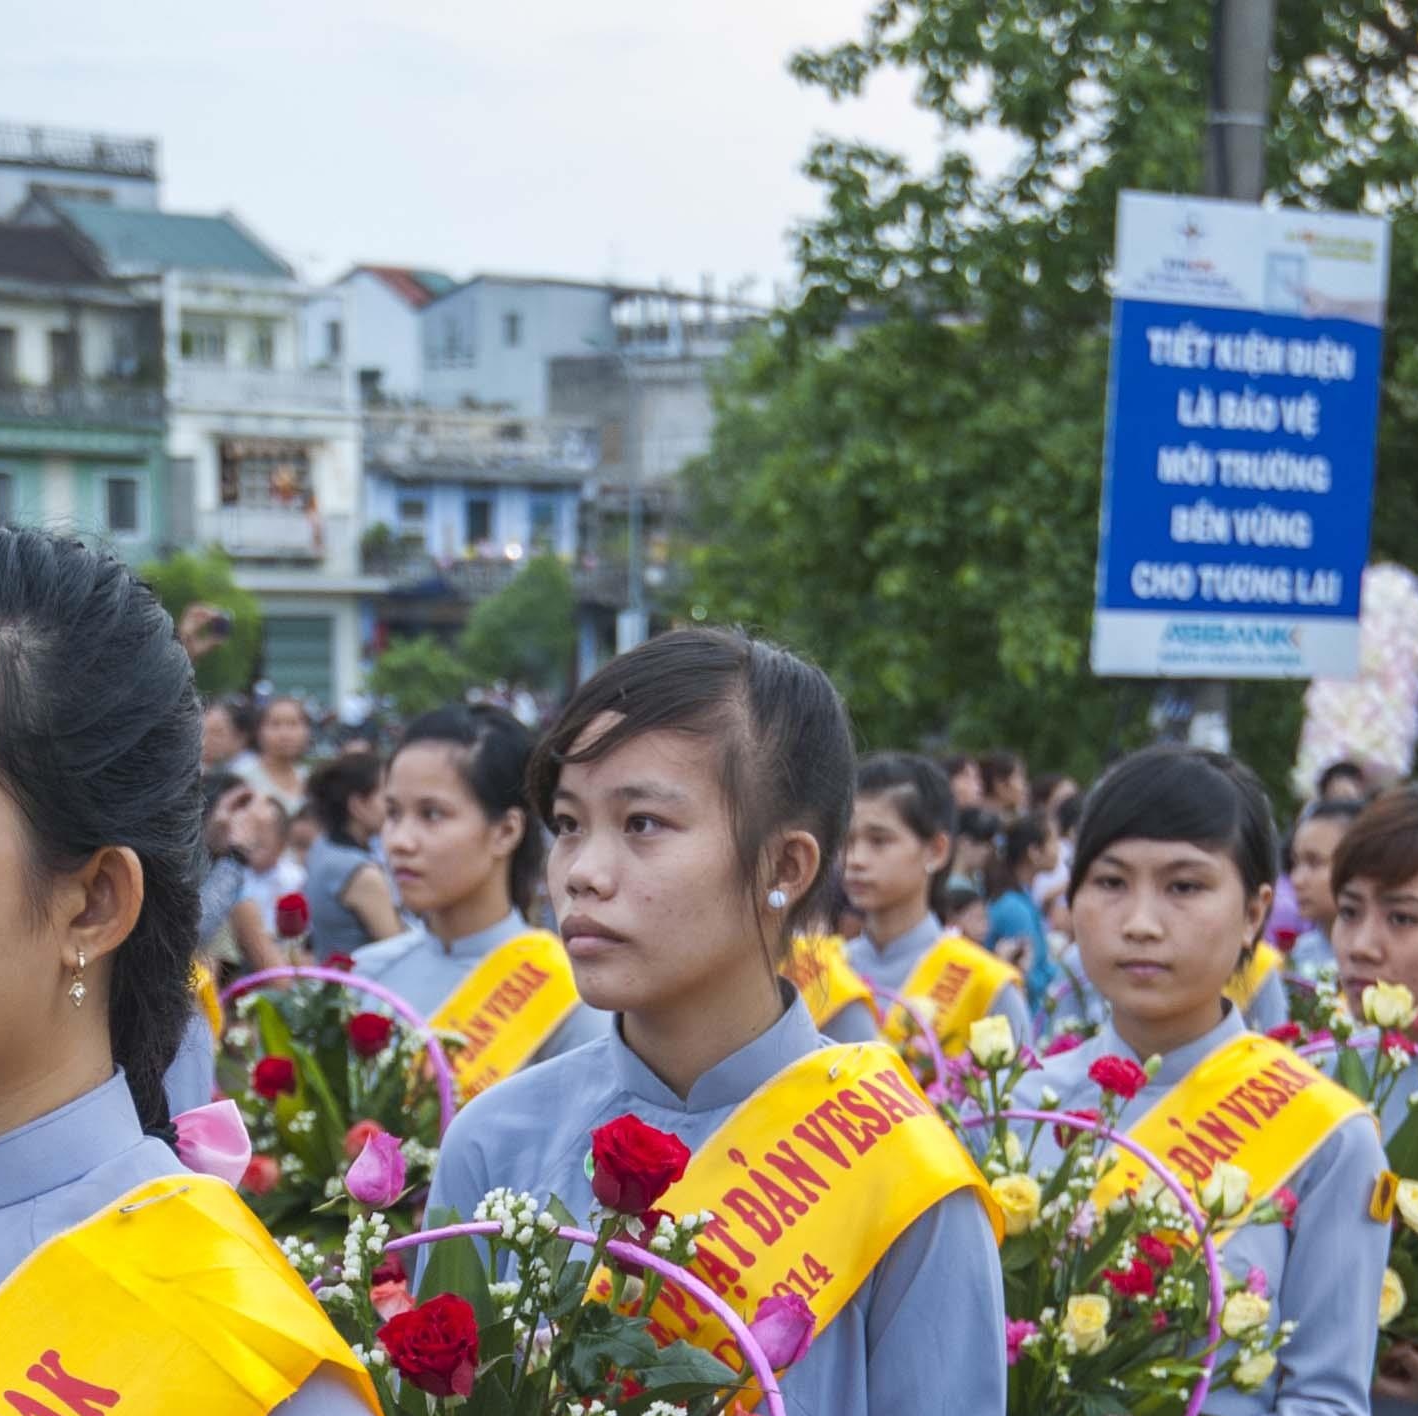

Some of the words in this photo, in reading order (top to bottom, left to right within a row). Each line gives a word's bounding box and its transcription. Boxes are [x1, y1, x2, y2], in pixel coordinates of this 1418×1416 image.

[1218, 1058, 1317, 1130] VESAK
[721, 1140, 831, 1247] ĐẢN
[793, 1070, 924, 1169] VESAK
